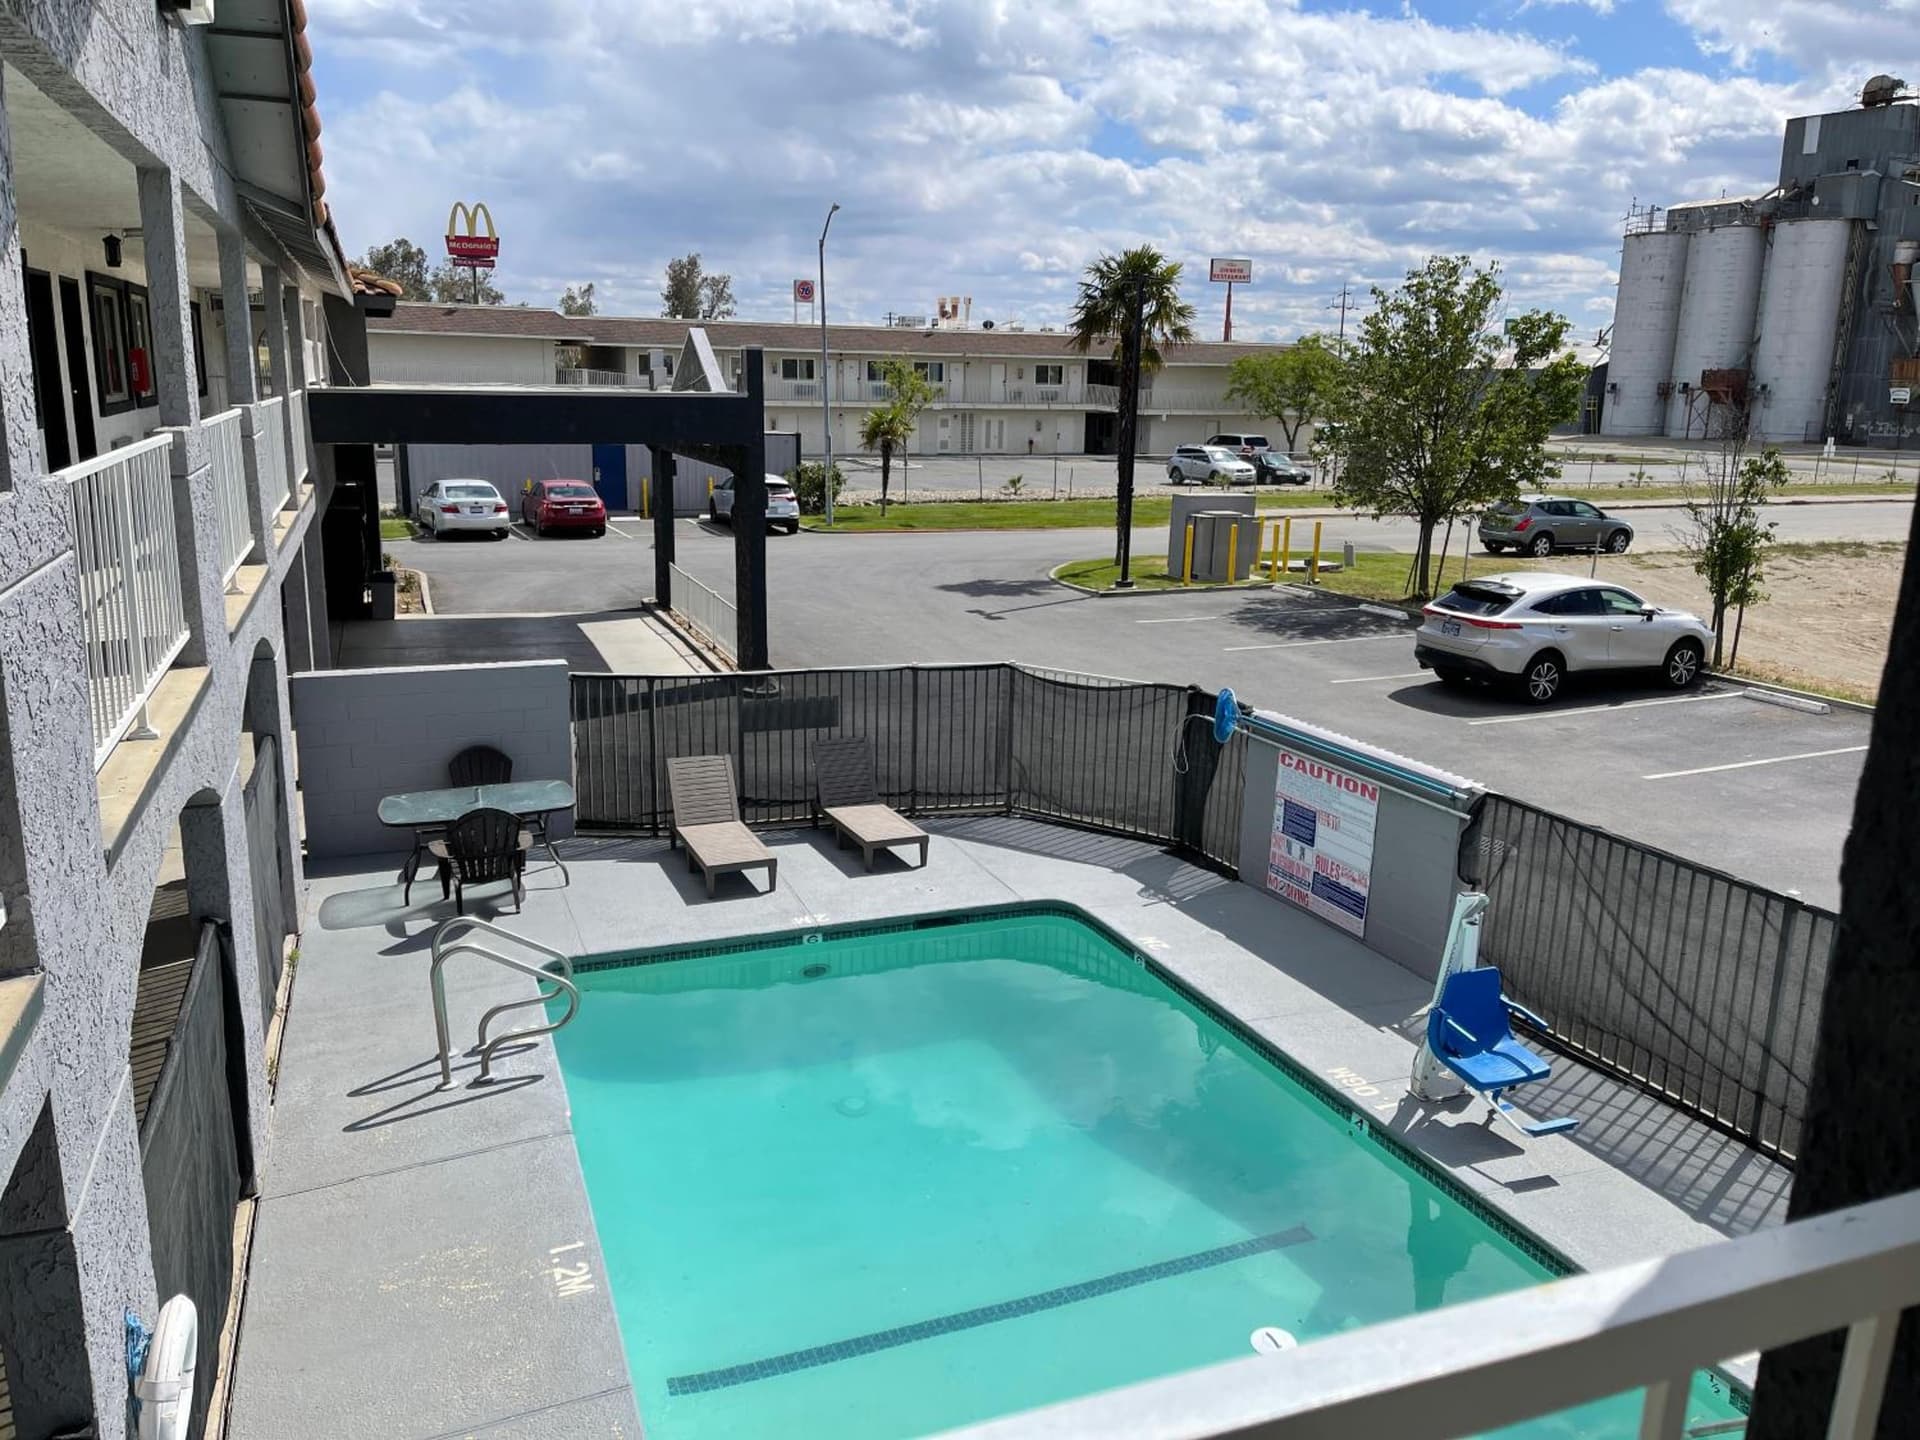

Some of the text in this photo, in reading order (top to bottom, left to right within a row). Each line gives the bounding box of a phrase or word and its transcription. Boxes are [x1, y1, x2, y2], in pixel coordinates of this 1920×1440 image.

[448, 241, 497, 250] McDonald's
[799, 286, 811, 295] 76
[1280, 752, 1378, 802] CAUTION
[1315, 854, 1341, 881] RULES
[549, 1240, 595, 1298] 1.2M
